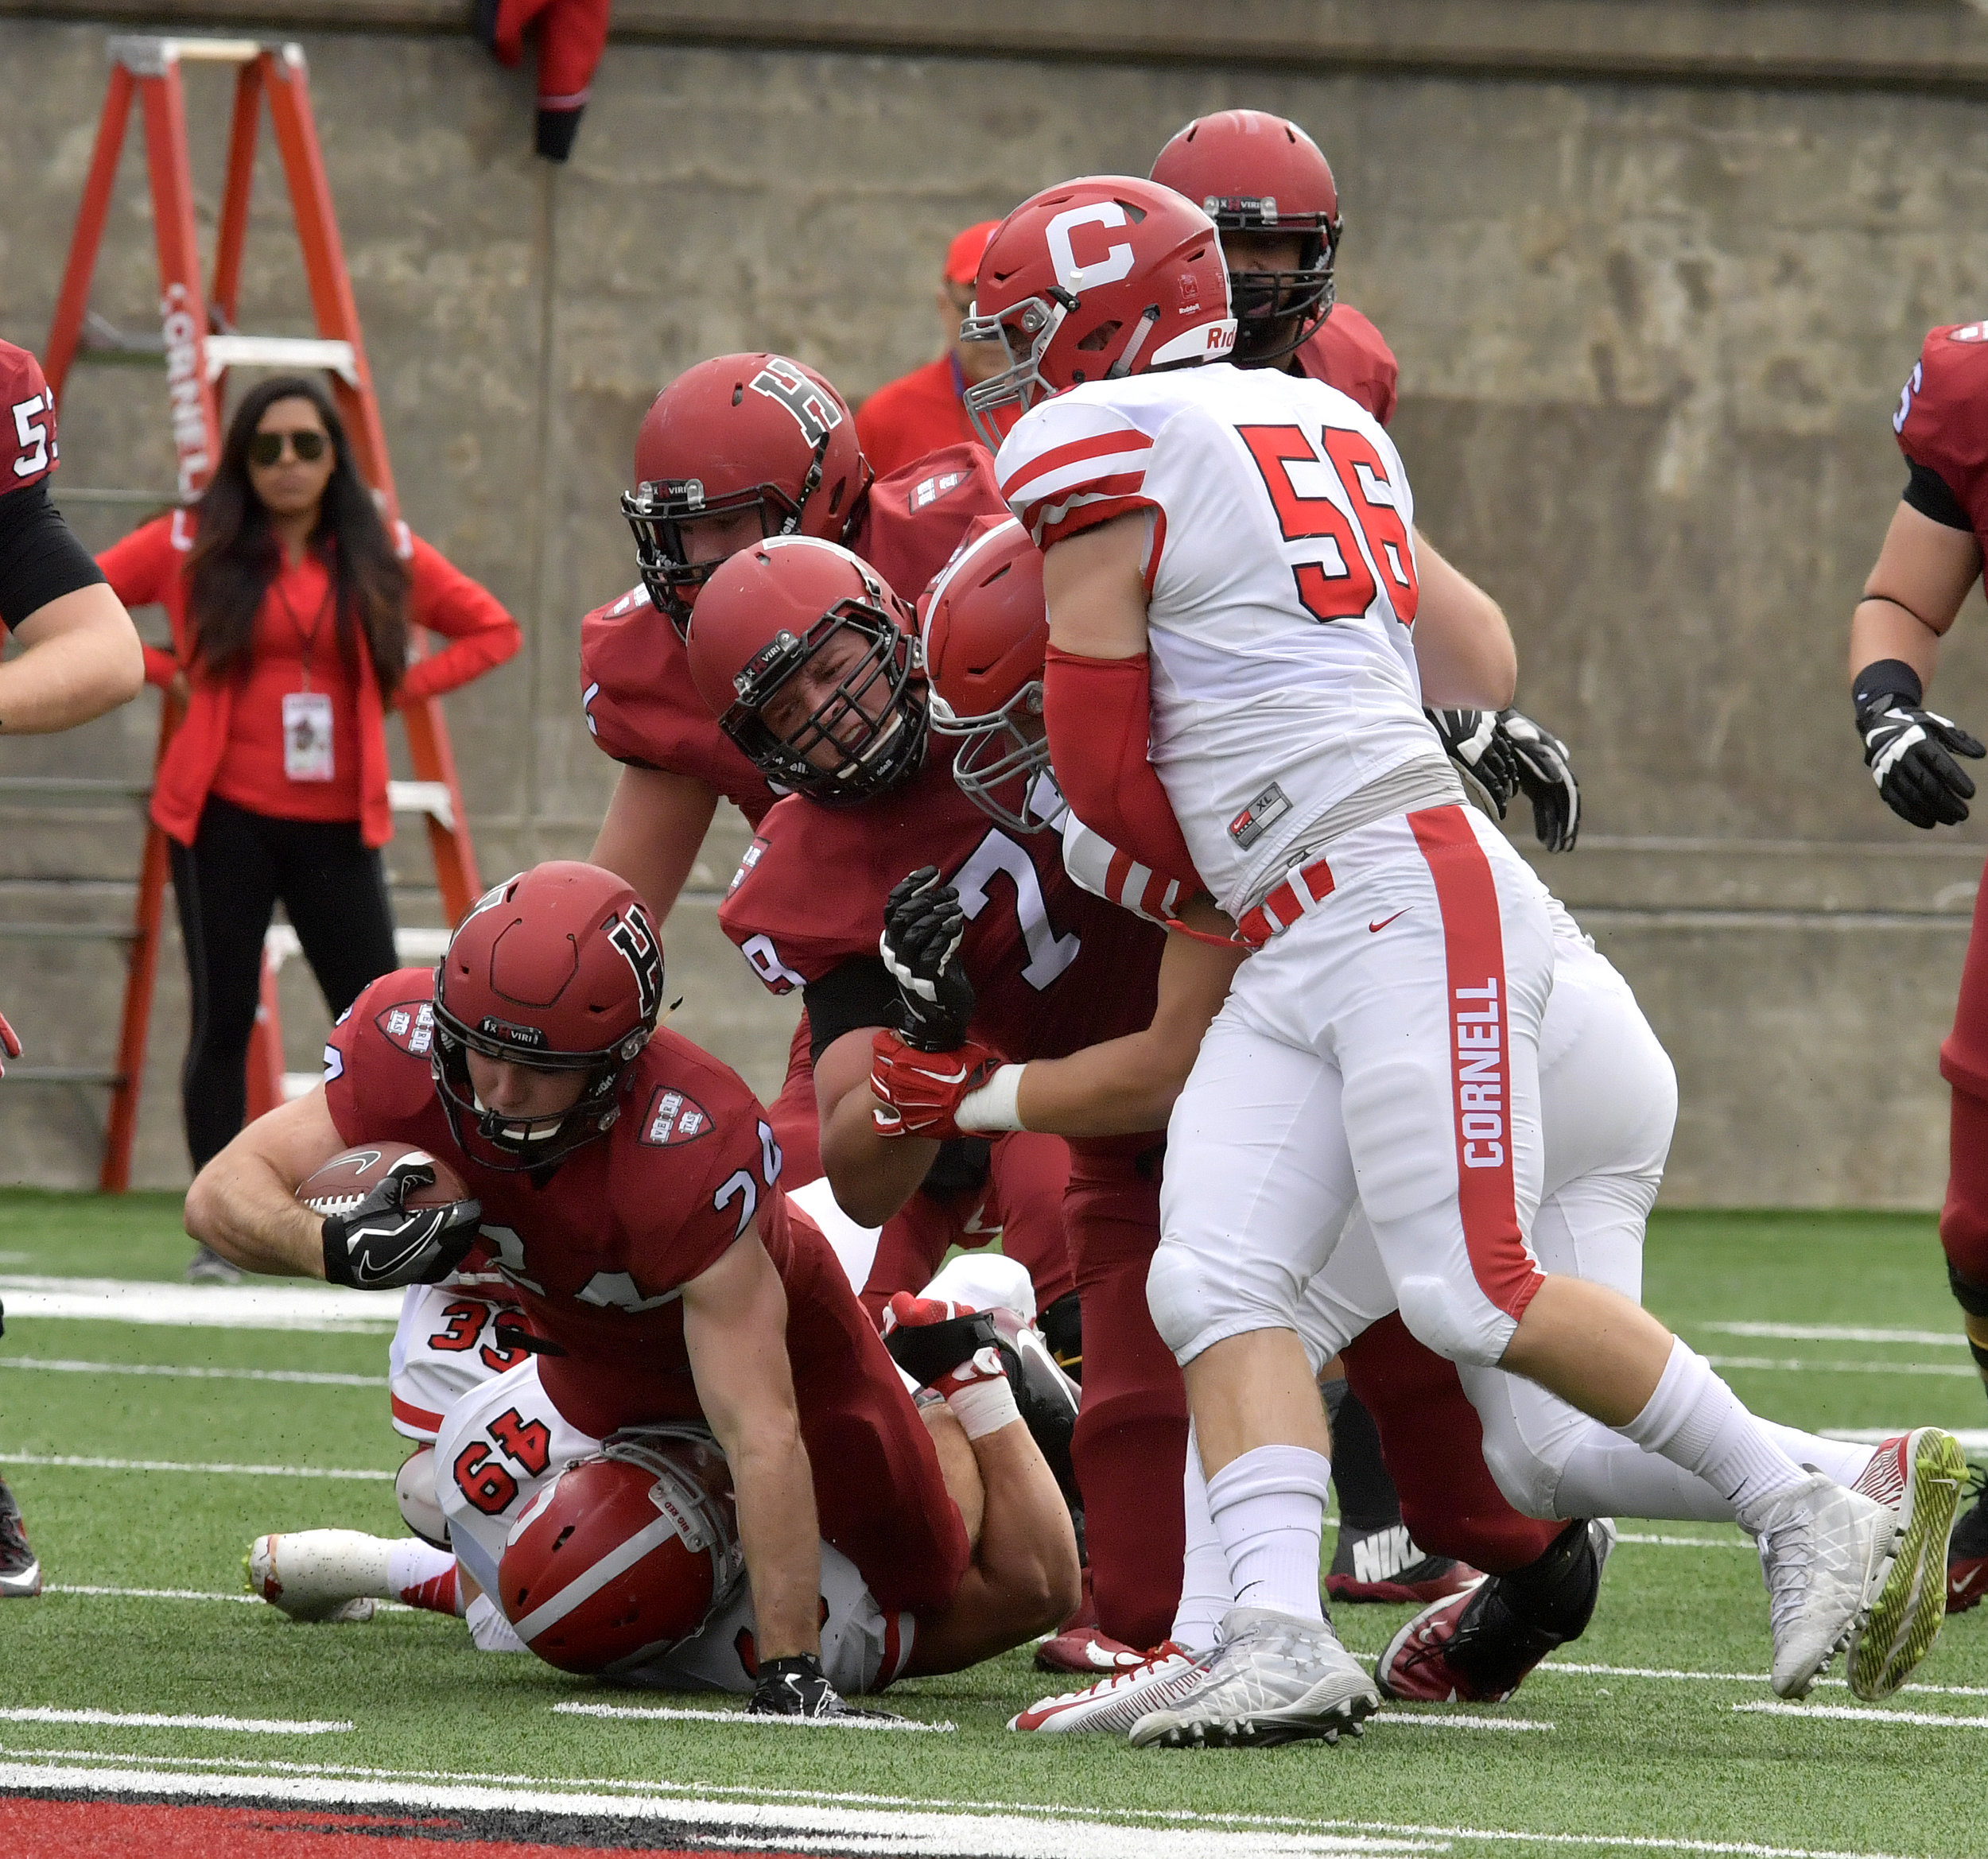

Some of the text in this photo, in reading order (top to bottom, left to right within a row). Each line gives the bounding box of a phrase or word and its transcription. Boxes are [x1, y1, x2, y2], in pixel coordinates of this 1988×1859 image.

[1045, 201, 1135, 297] C
[748, 358, 843, 449] H
[1233, 424, 1411, 632] 56
[1256, 796, 1272, 812] XL
[608, 904, 664, 1019] H
[511, 1030, 532, 1043] VIRI
[1456, 977, 1505, 1168] CORNELL
[684, 1115, 696, 1129] TAS
[452, 1406, 551, 1516] 49
[664, 1501, 689, 1533] BIG RED
